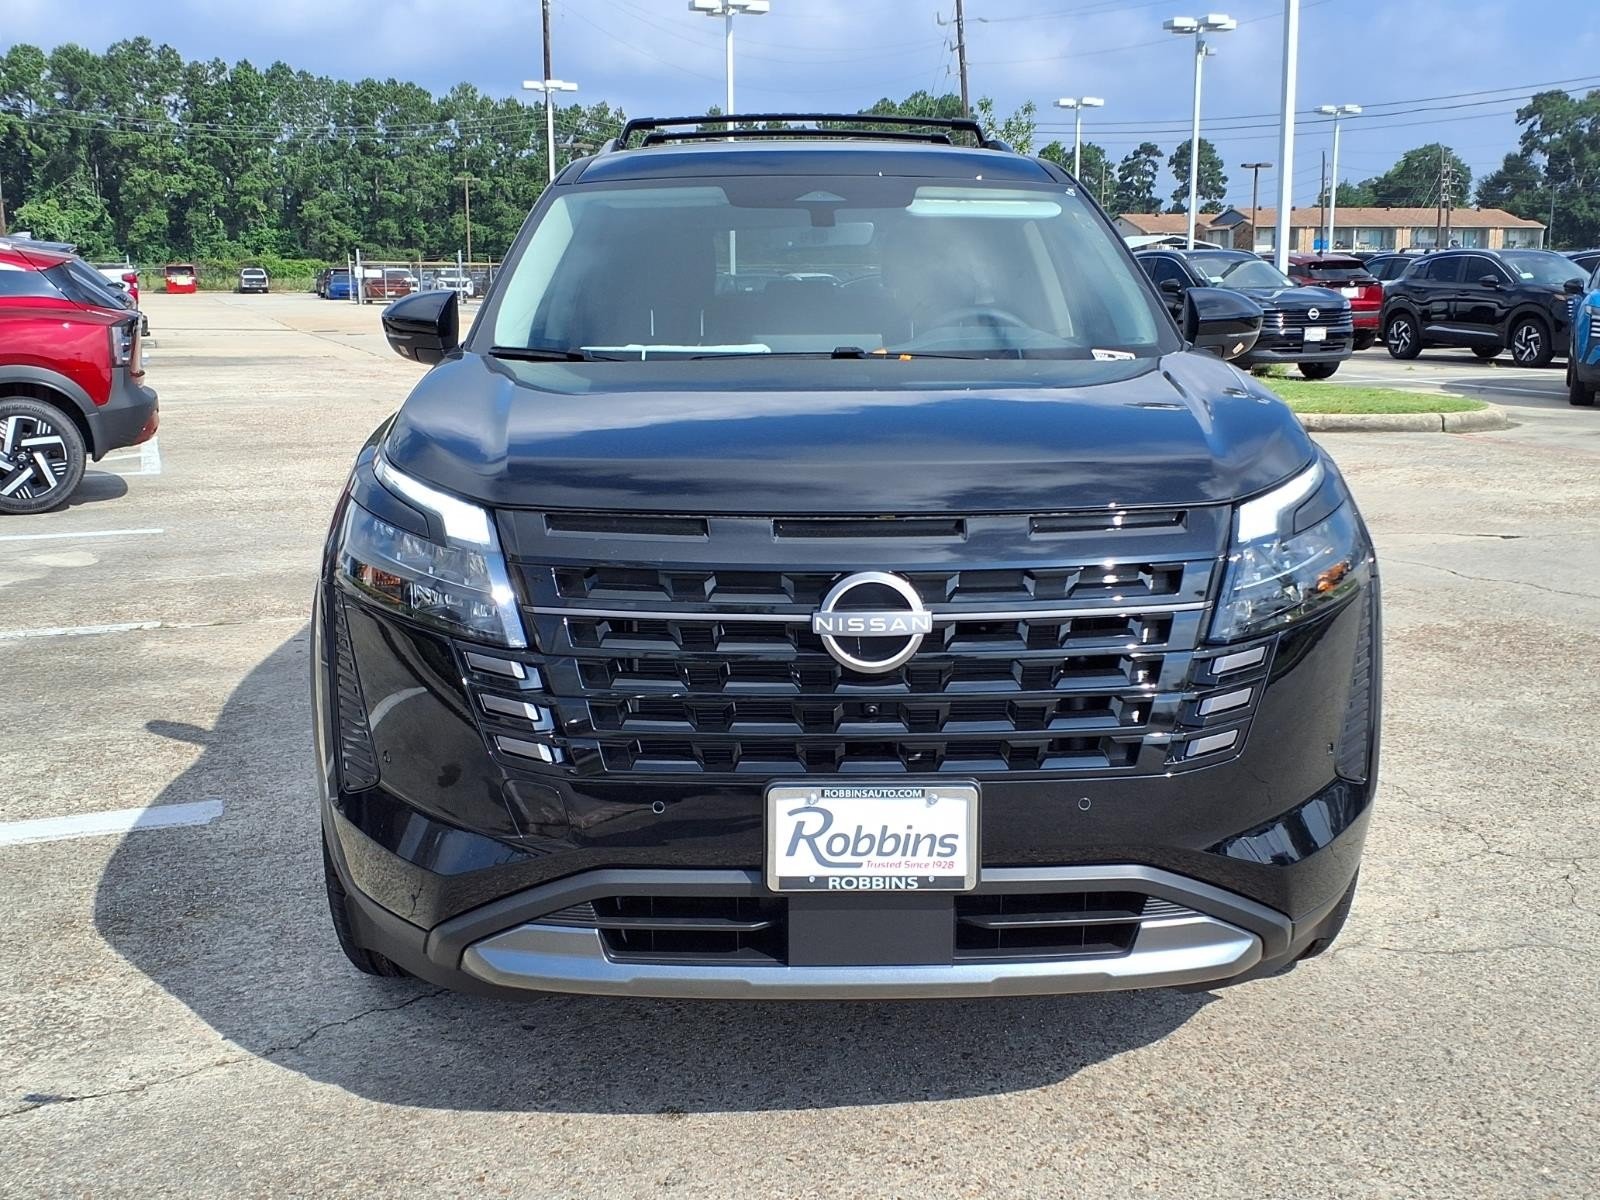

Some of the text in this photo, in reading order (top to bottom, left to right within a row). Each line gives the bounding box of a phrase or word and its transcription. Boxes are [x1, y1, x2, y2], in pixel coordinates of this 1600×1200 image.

[815, 616, 929, 632] NISSAN
[824, 789, 922, 798] ROBBINSAUTO.COM
[785, 806, 959, 868] Robbins
[866, 860, 955, 869] Trusted Since 1928
[828, 876, 919, 889] ROBBINS
